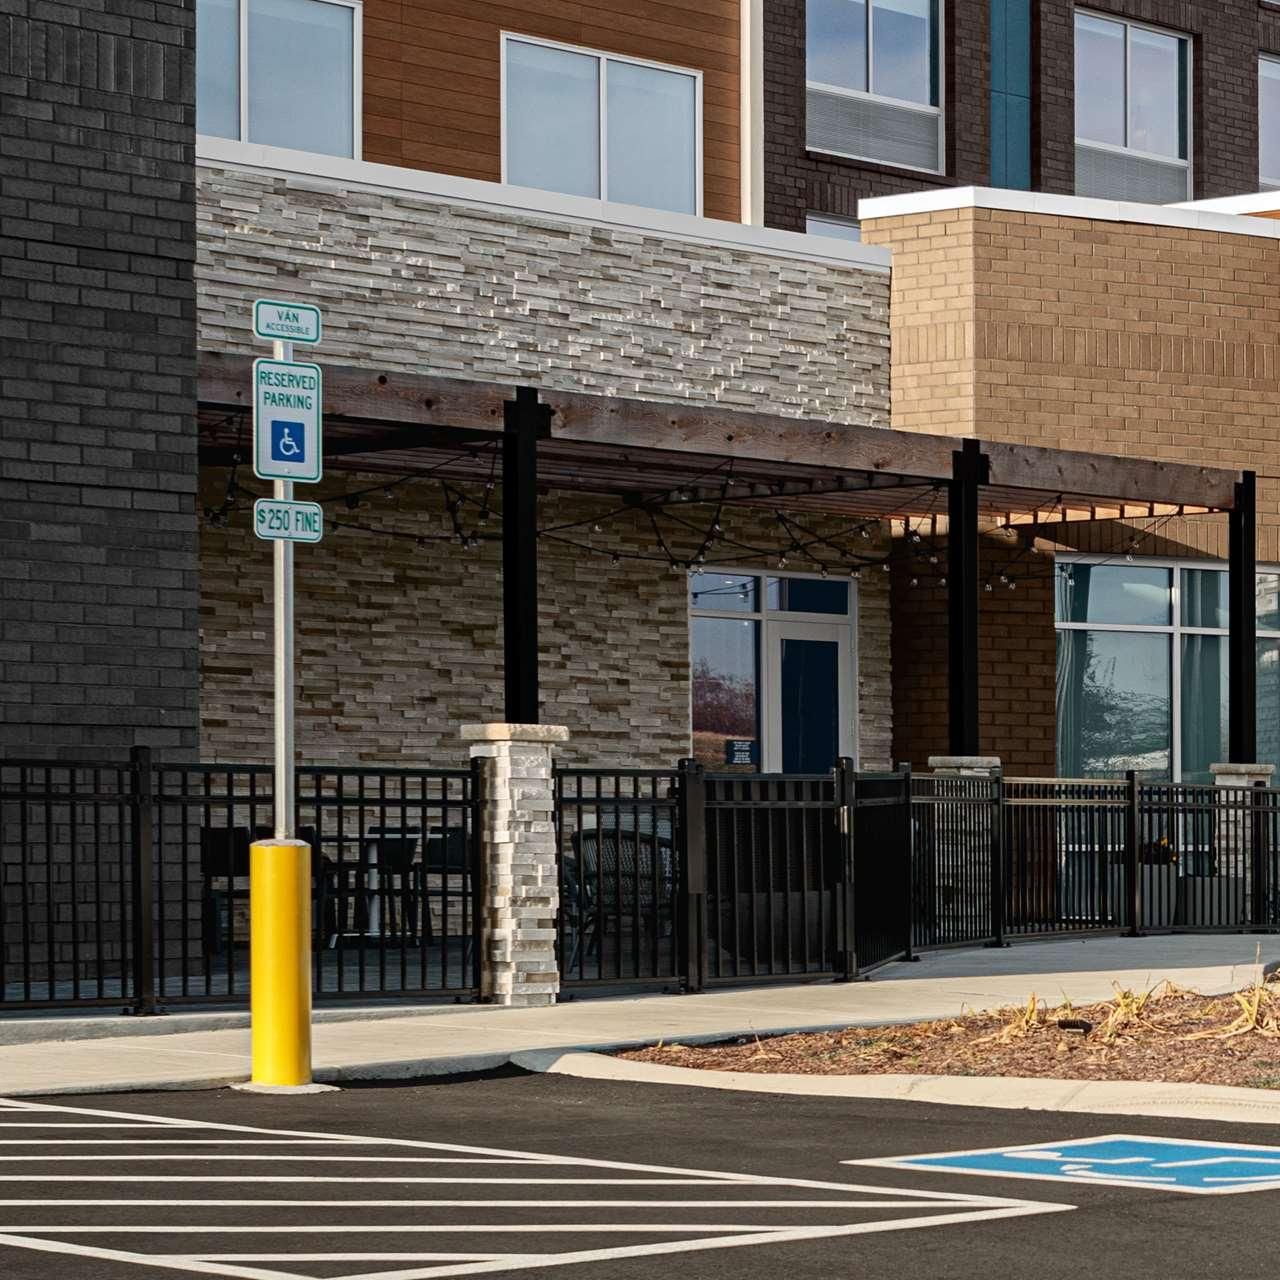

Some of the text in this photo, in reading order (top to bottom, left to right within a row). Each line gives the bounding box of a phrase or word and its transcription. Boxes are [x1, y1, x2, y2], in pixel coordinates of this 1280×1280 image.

[277, 310, 299, 323] VAN
[265, 323, 311, 335] ACCESSIBLE
[259, 370, 316, 391] RESERVED
[263, 391, 313, 410] PARKING
[257, 508, 321, 532] $250 FINE
